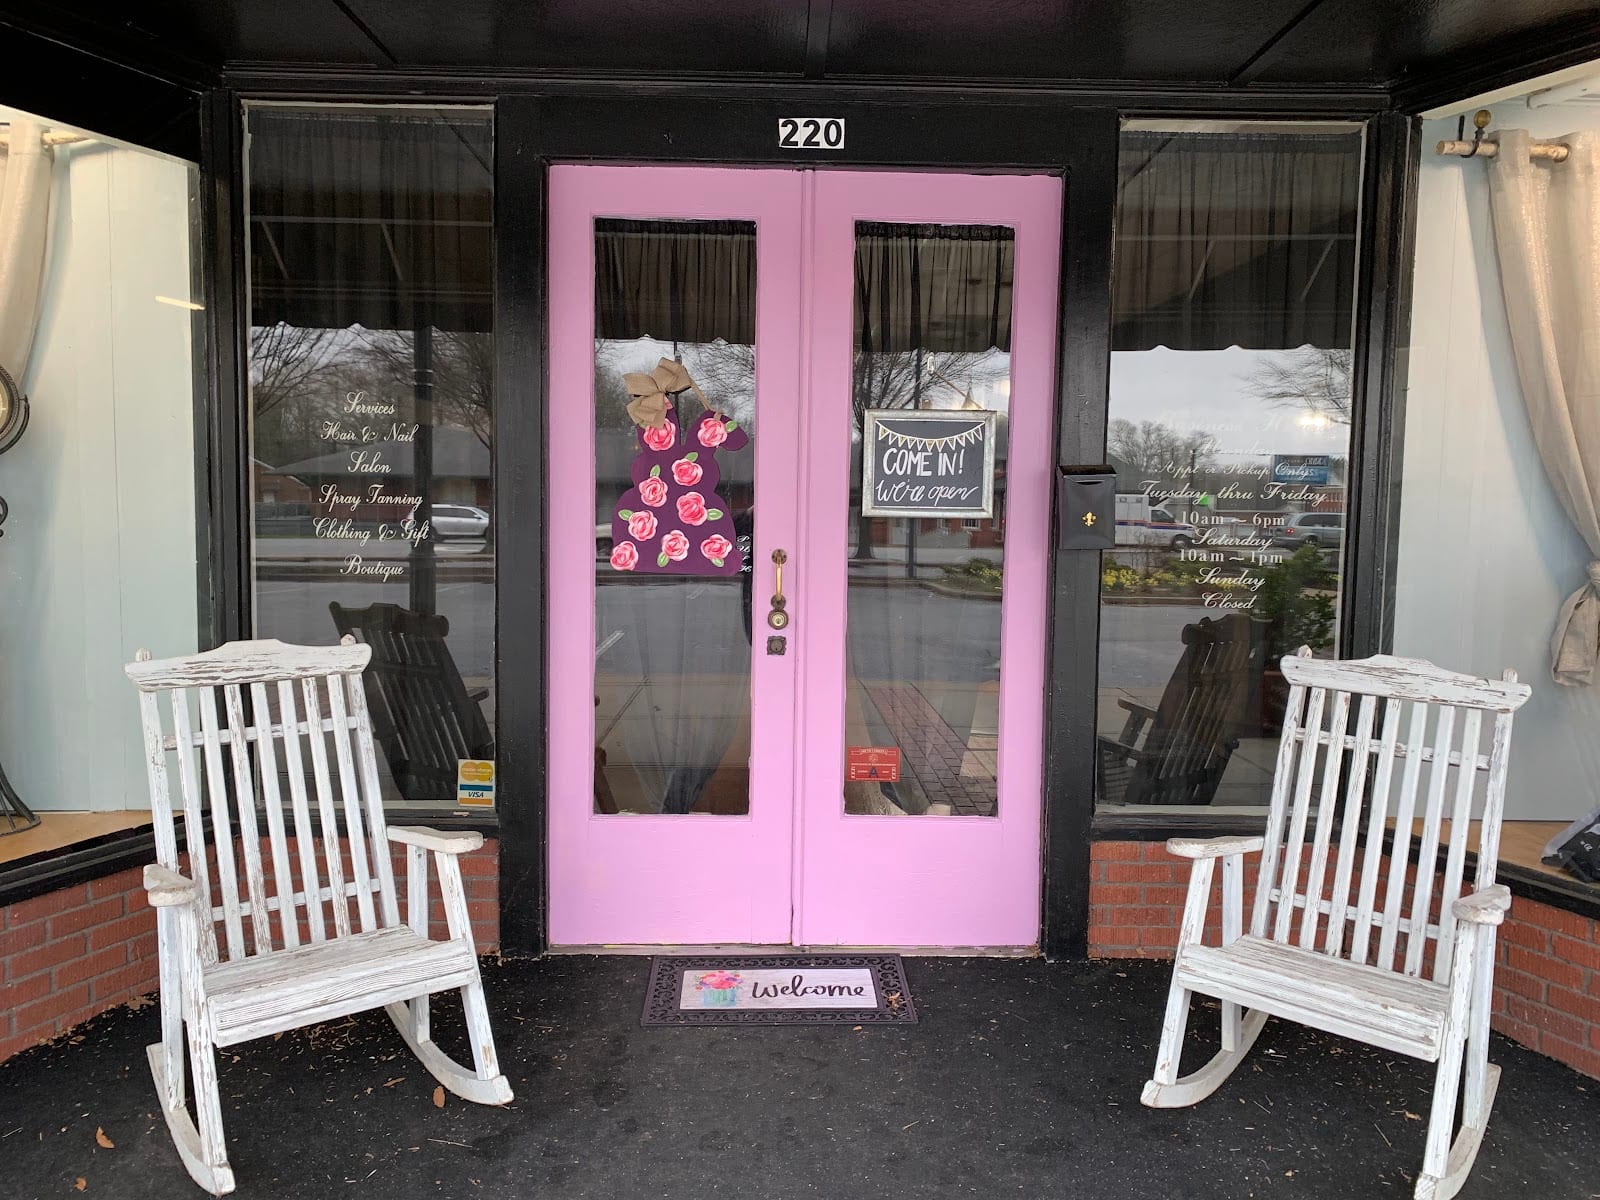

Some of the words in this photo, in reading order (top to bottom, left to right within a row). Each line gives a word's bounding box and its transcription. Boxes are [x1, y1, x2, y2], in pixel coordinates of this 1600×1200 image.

[780, 119, 843, 147] 220
[344, 391, 396, 415] Services
[320, 421, 357, 441] Hair
[361, 426, 379, 443] &
[383, 422, 420, 442] Nail
[347, 450, 392, 474] Salon
[882, 447, 933, 477] COME
[937, 448, 965, 477] IN!
[1156, 460, 1204, 481] Appt
[1223, 463, 1270, 481] Pickup
[318, 484, 362, 512] Spray
[366, 484, 424, 512] Tanning
[927, 485, 979, 507] open
[1137, 480, 1208, 506] Tuesday
[1216, 482, 1254, 501] thru
[1260, 482, 1328, 507] Friday
[1181, 511, 1225, 526] 10am
[1252, 512, 1286, 528] 6pm
[312, 517, 372, 547] Clothing
[378, 524, 397, 542] &
[400, 519, 430, 547] Gift
[1191, 527, 1274, 552] Saturday
[340, 553, 405, 583] Boutique
[1179, 548, 1225, 563] 10am
[1250, 549, 1284, 565] 1pm
[1195, 566, 1266, 592] Sunday
[1201, 592, 1257, 610] Closed
